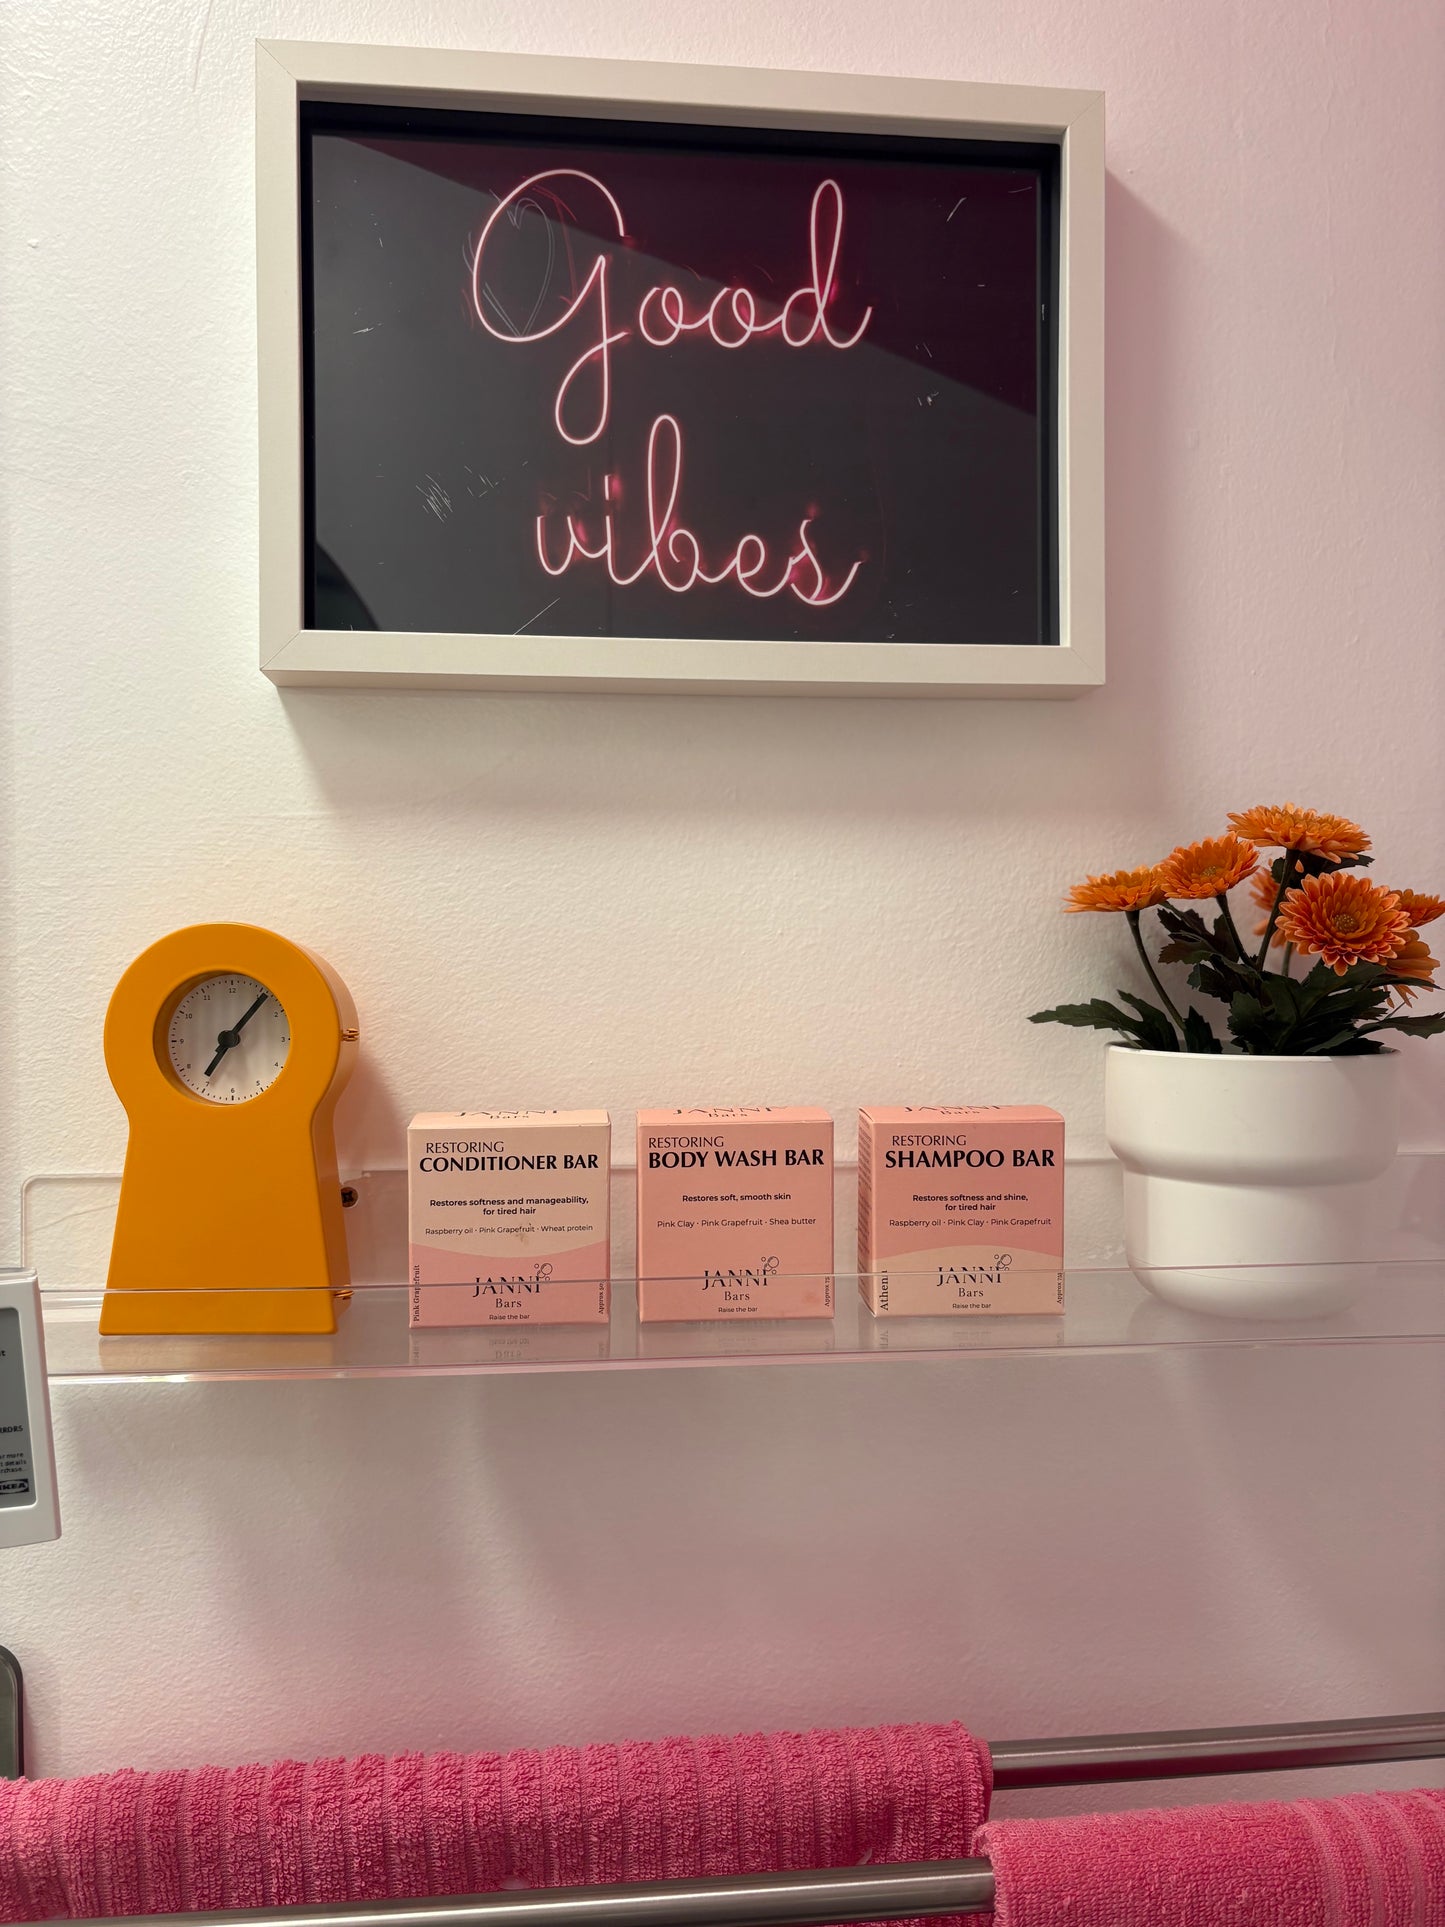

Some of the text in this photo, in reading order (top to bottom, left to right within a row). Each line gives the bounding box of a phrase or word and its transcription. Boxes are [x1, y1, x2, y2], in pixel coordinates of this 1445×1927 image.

[472, 169, 872, 445] Good
[537, 414, 862, 606] vibes
[648, 1136, 724, 1148] RESTORING
[892, 1135, 966, 1146] RESTORING
[426, 1141, 504, 1154] RESTORING
[419, 1154, 599, 1172] CONDITIONER BAR
[648, 1149, 824, 1168] BODY WASH BAR
[885, 1149, 1055, 1168] SHAMPOO BAR
[526, 1196, 589, 1206] manageability,
[720, 1194, 738, 1202] soft,
[677, 1220, 695, 1229] Clay
[721, 1219, 763, 1227] Grapefruit
[889, 1220, 930, 1228] Raspberry
[967, 1219, 985, 1228] Clay
[1010, 1218, 1051, 1227] Grapefruit
[425, 1228, 463, 1236] Raspberry
[497, 1226, 535, 1234] Grapefruit
[566, 1224, 593, 1232] protein
[702, 1269, 768, 1290] JANNI
[936, 1266, 1001, 1286] JANNI
[472, 1276, 540, 1297] JANNI
[958, 1288, 984, 1297] Bars
[724, 1291, 750, 1301] Bars
[496, 1298, 522, 1308] Bars
